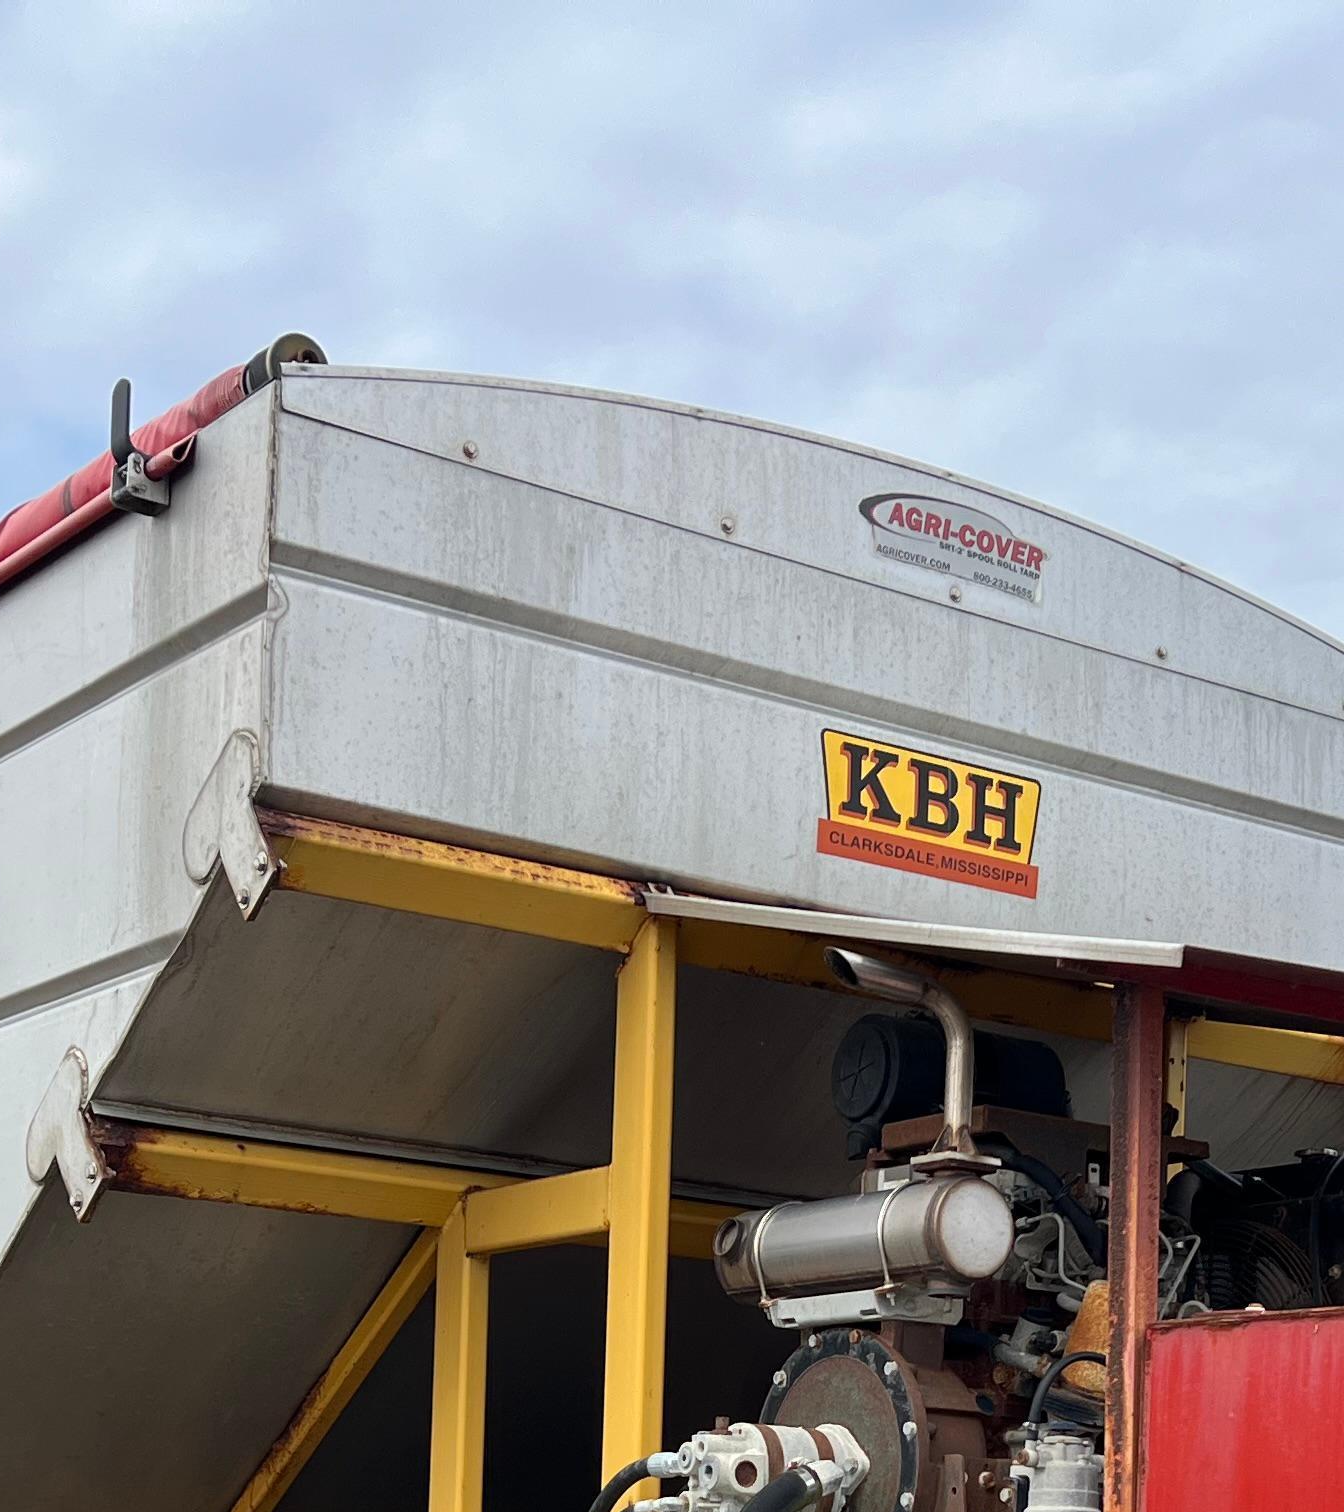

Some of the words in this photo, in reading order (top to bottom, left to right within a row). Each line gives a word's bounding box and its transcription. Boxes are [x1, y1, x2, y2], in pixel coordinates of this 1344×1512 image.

[888, 502, 1043, 572] AGRI-COVER
[876, 543, 951, 572] AGRICOVER.COM
[967, 551, 994, 566] SPOOL
[997, 560, 1017, 573] ROLL
[1019, 567, 1040, 581] TARP
[973, 571, 1033, 599] 800-233-4655
[838, 741, 1024, 856] KBH
